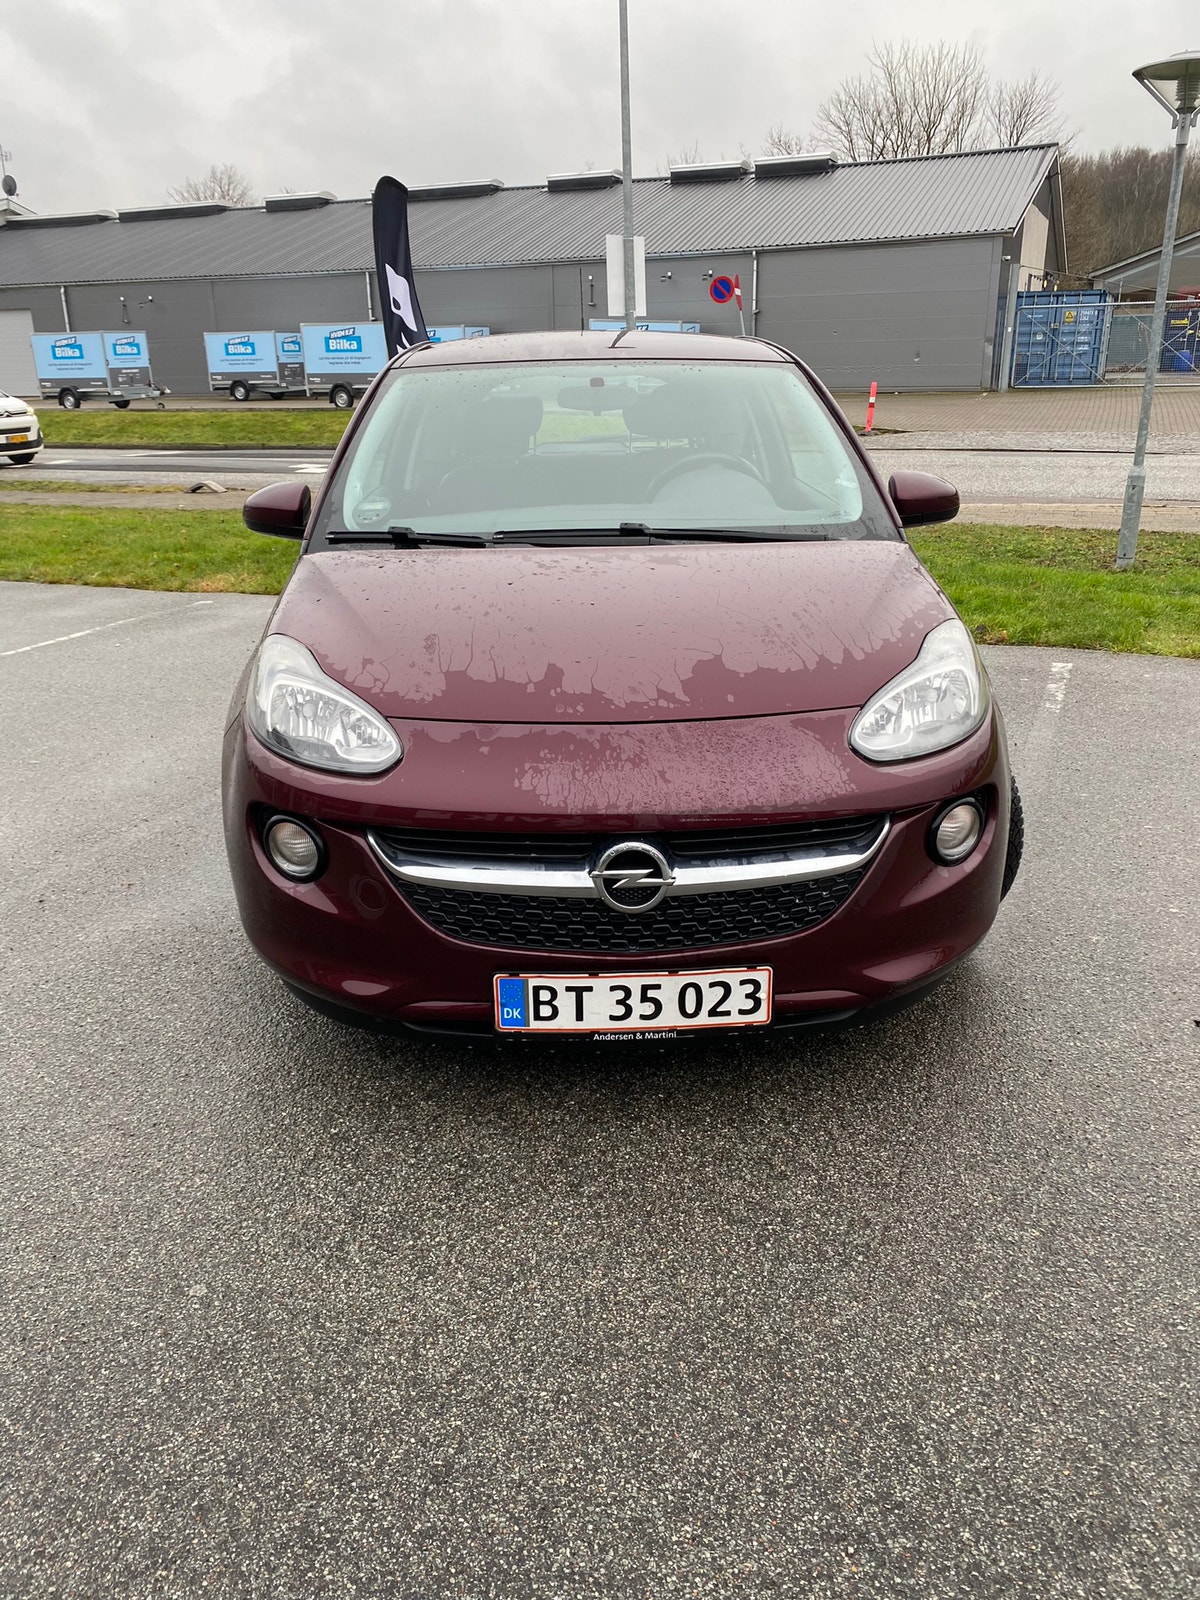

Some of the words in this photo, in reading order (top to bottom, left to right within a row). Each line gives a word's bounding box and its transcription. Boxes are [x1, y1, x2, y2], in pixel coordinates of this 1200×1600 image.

[116, 345, 138, 354] Bilka
[228, 344, 252, 354] Bilka
[283, 343, 299, 351] Bilka
[328, 339, 358, 350] Bilka
[55, 347, 80, 357] Bilka
[532, 984, 594, 1022] BT
[608, 983, 663, 1022] 35
[677, 978, 763, 1020] 023
[503, 1007, 522, 1020] DK
[593, 1033, 634, 1041] Andersen
[635, 1032, 643, 1040] &
[644, 1031, 677, 1039] Martini
